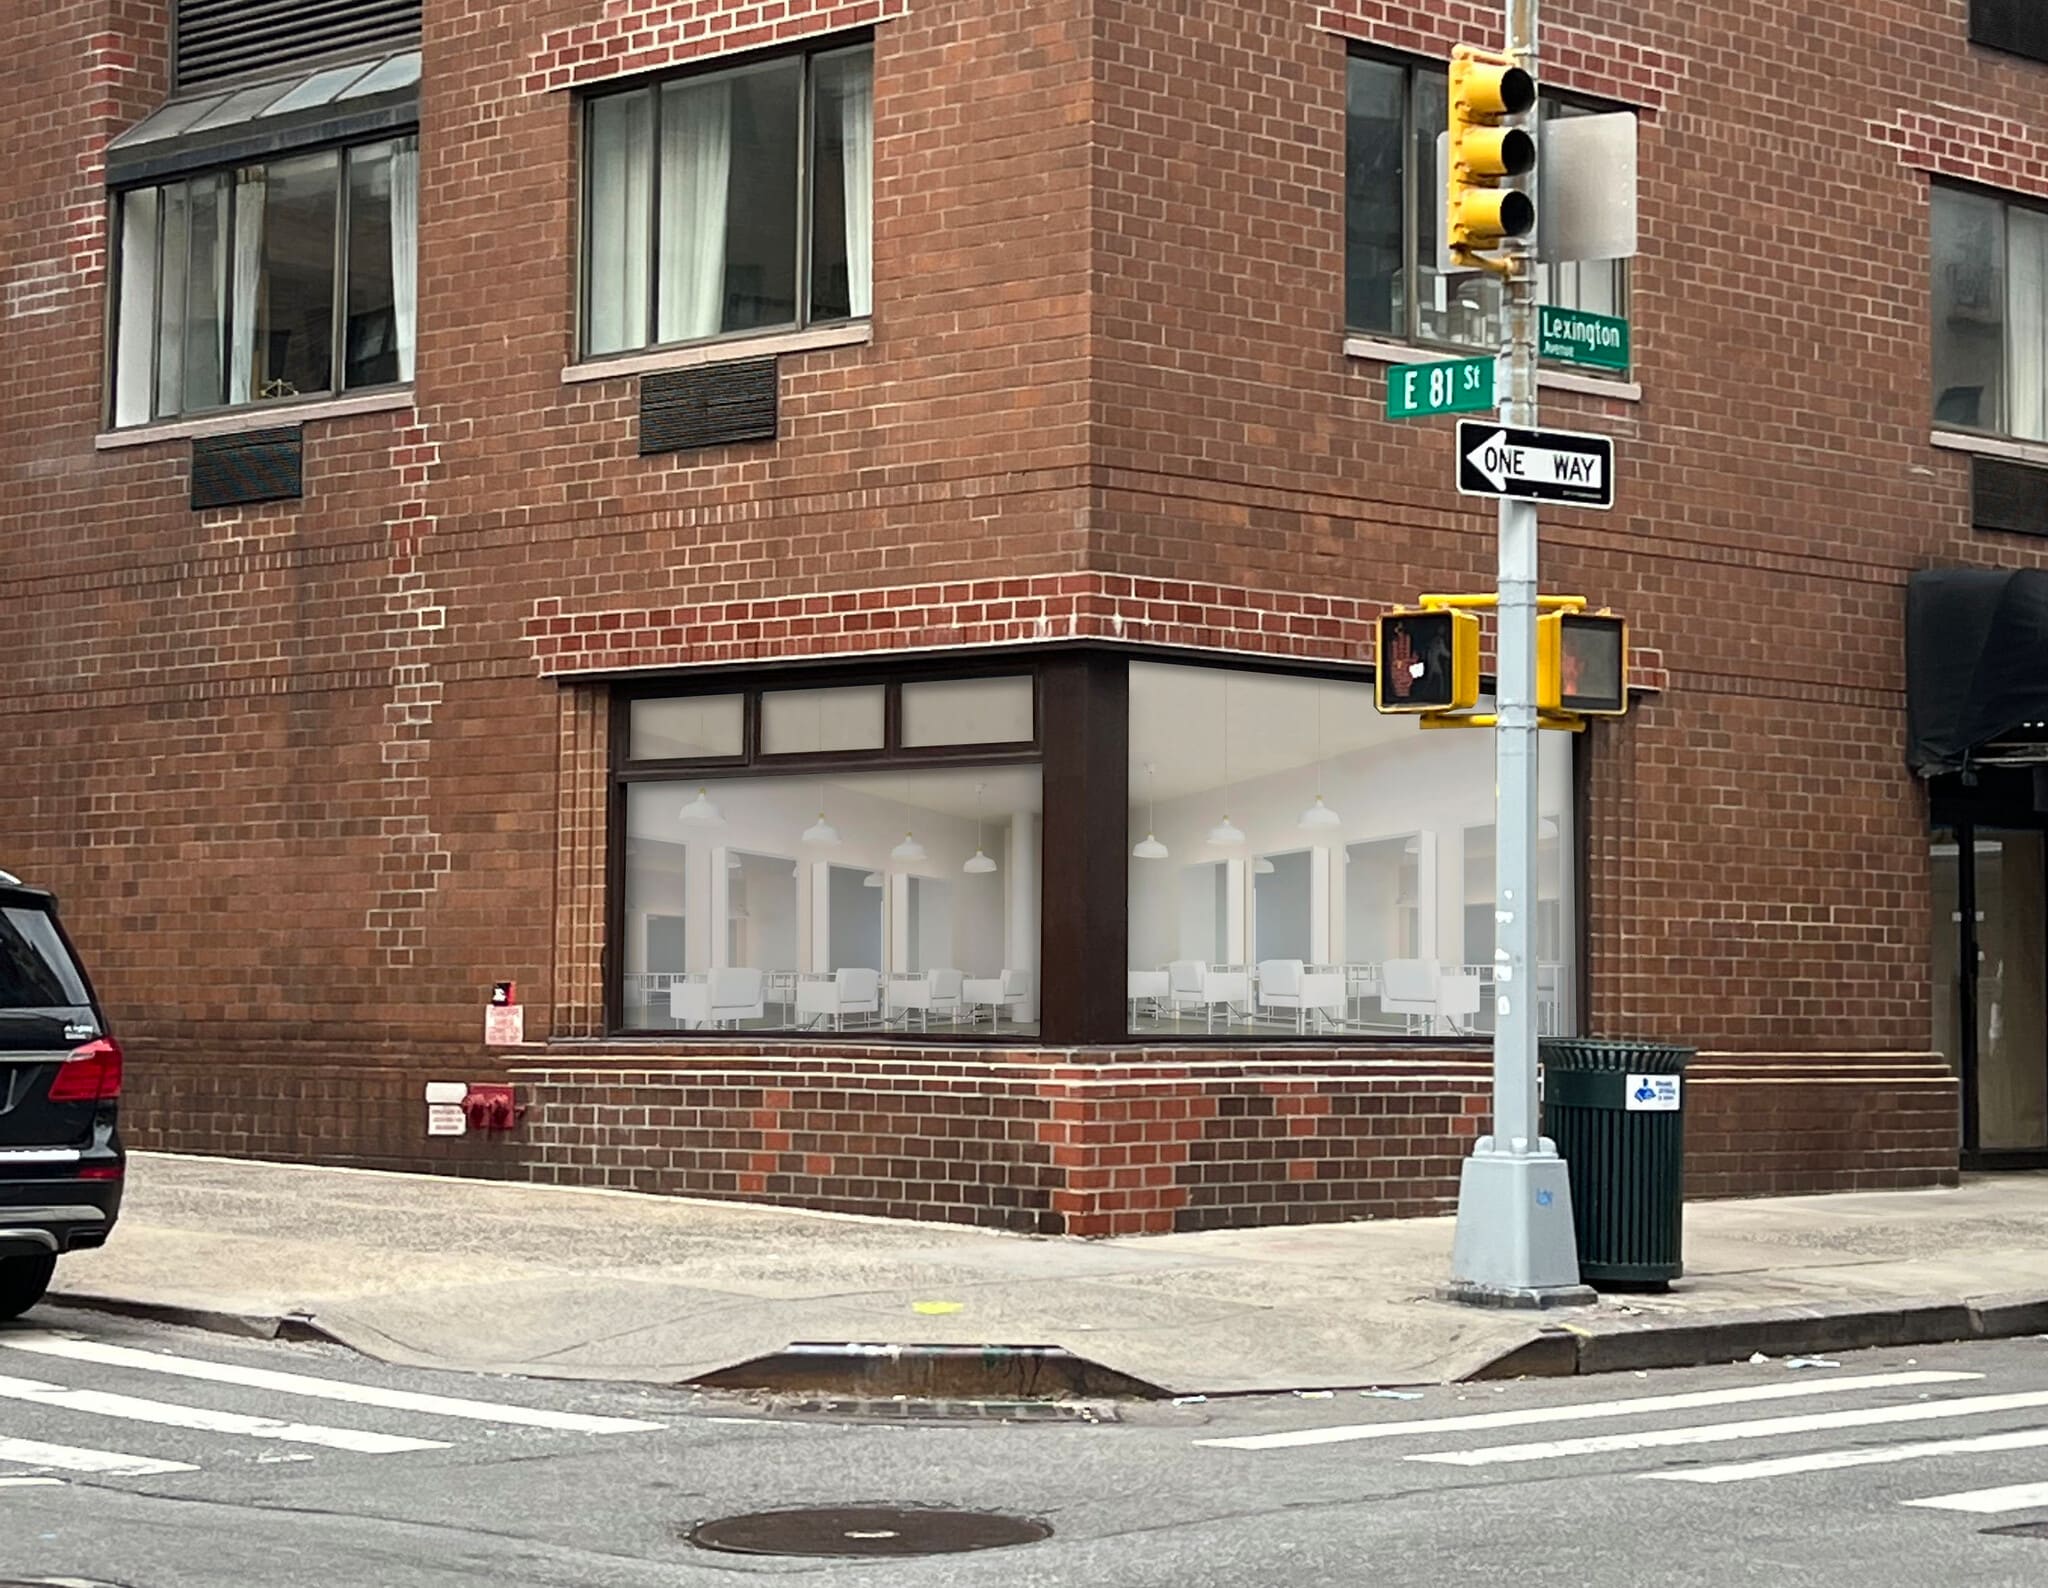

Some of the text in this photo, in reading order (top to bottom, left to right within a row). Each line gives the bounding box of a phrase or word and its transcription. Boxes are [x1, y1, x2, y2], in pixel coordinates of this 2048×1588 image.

[1543, 311, 1620, 351] Lexington
[1543, 341, 1575, 358] Avenue
[1404, 364, 1480, 410] E 81 St
[1484, 446, 1596, 483] ONE WAY
